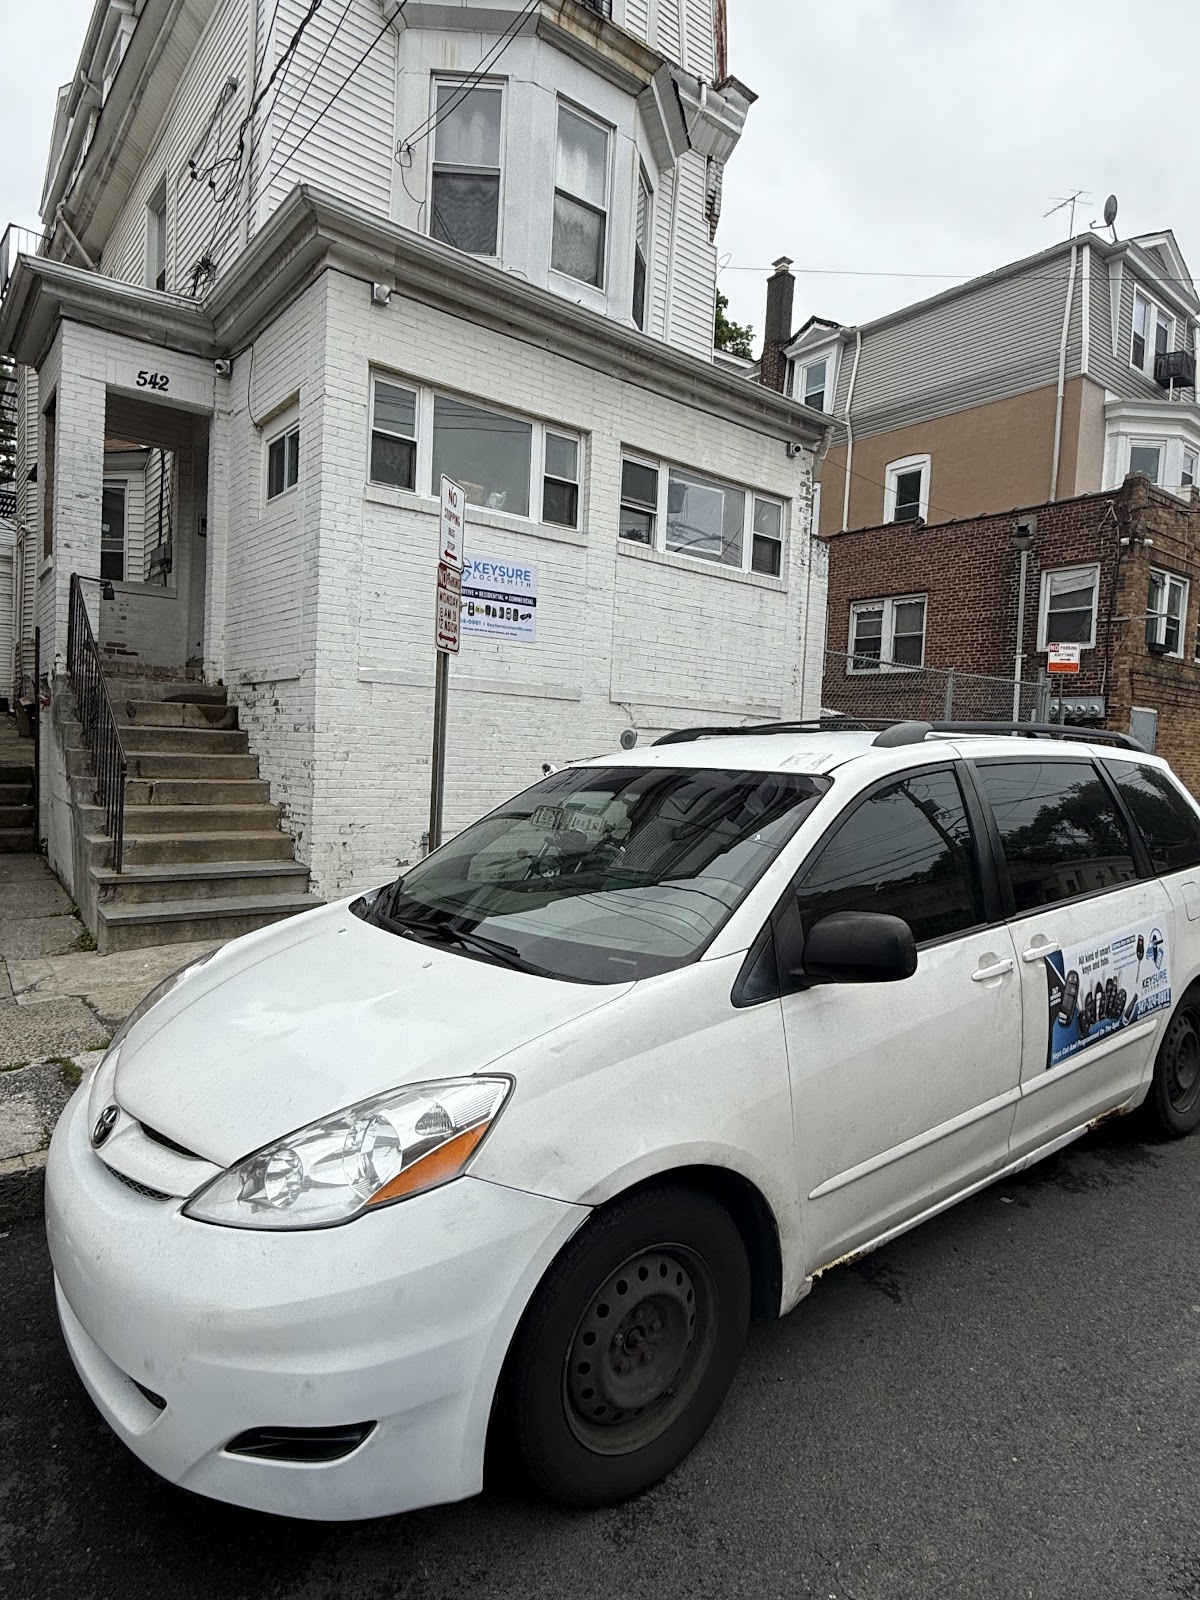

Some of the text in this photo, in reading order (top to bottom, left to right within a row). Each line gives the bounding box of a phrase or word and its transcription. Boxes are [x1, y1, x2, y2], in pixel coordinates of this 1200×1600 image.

[136, 370, 170, 392] 542
[448, 487, 457, 508] NO
[444, 507, 460, 527] STOPPING
[438, 566, 447, 587] NO
[472, 573, 531, 588] LOCKSMITH
[473, 561, 531, 582] KEYSURE
[439, 590, 458, 608] MONDAY
[478, 590, 505, 601] RESIDENTIAL
[508, 595, 535, 606] COMMERCIAL
[1050, 644, 1059, 652] NO
[1084, 950, 1094, 963] kind
[1099, 944, 1111, 957] smart
[1081, 964, 1092, 975] keys
[1092, 959, 1100, 970] and
[1141, 968, 1168, 990] KEYSURE
[1141, 979, 1168, 995] LOCKSMITH
[1061, 1045, 1070, 1055] Cut
[1111, 1020, 1120, 1030] Spot
